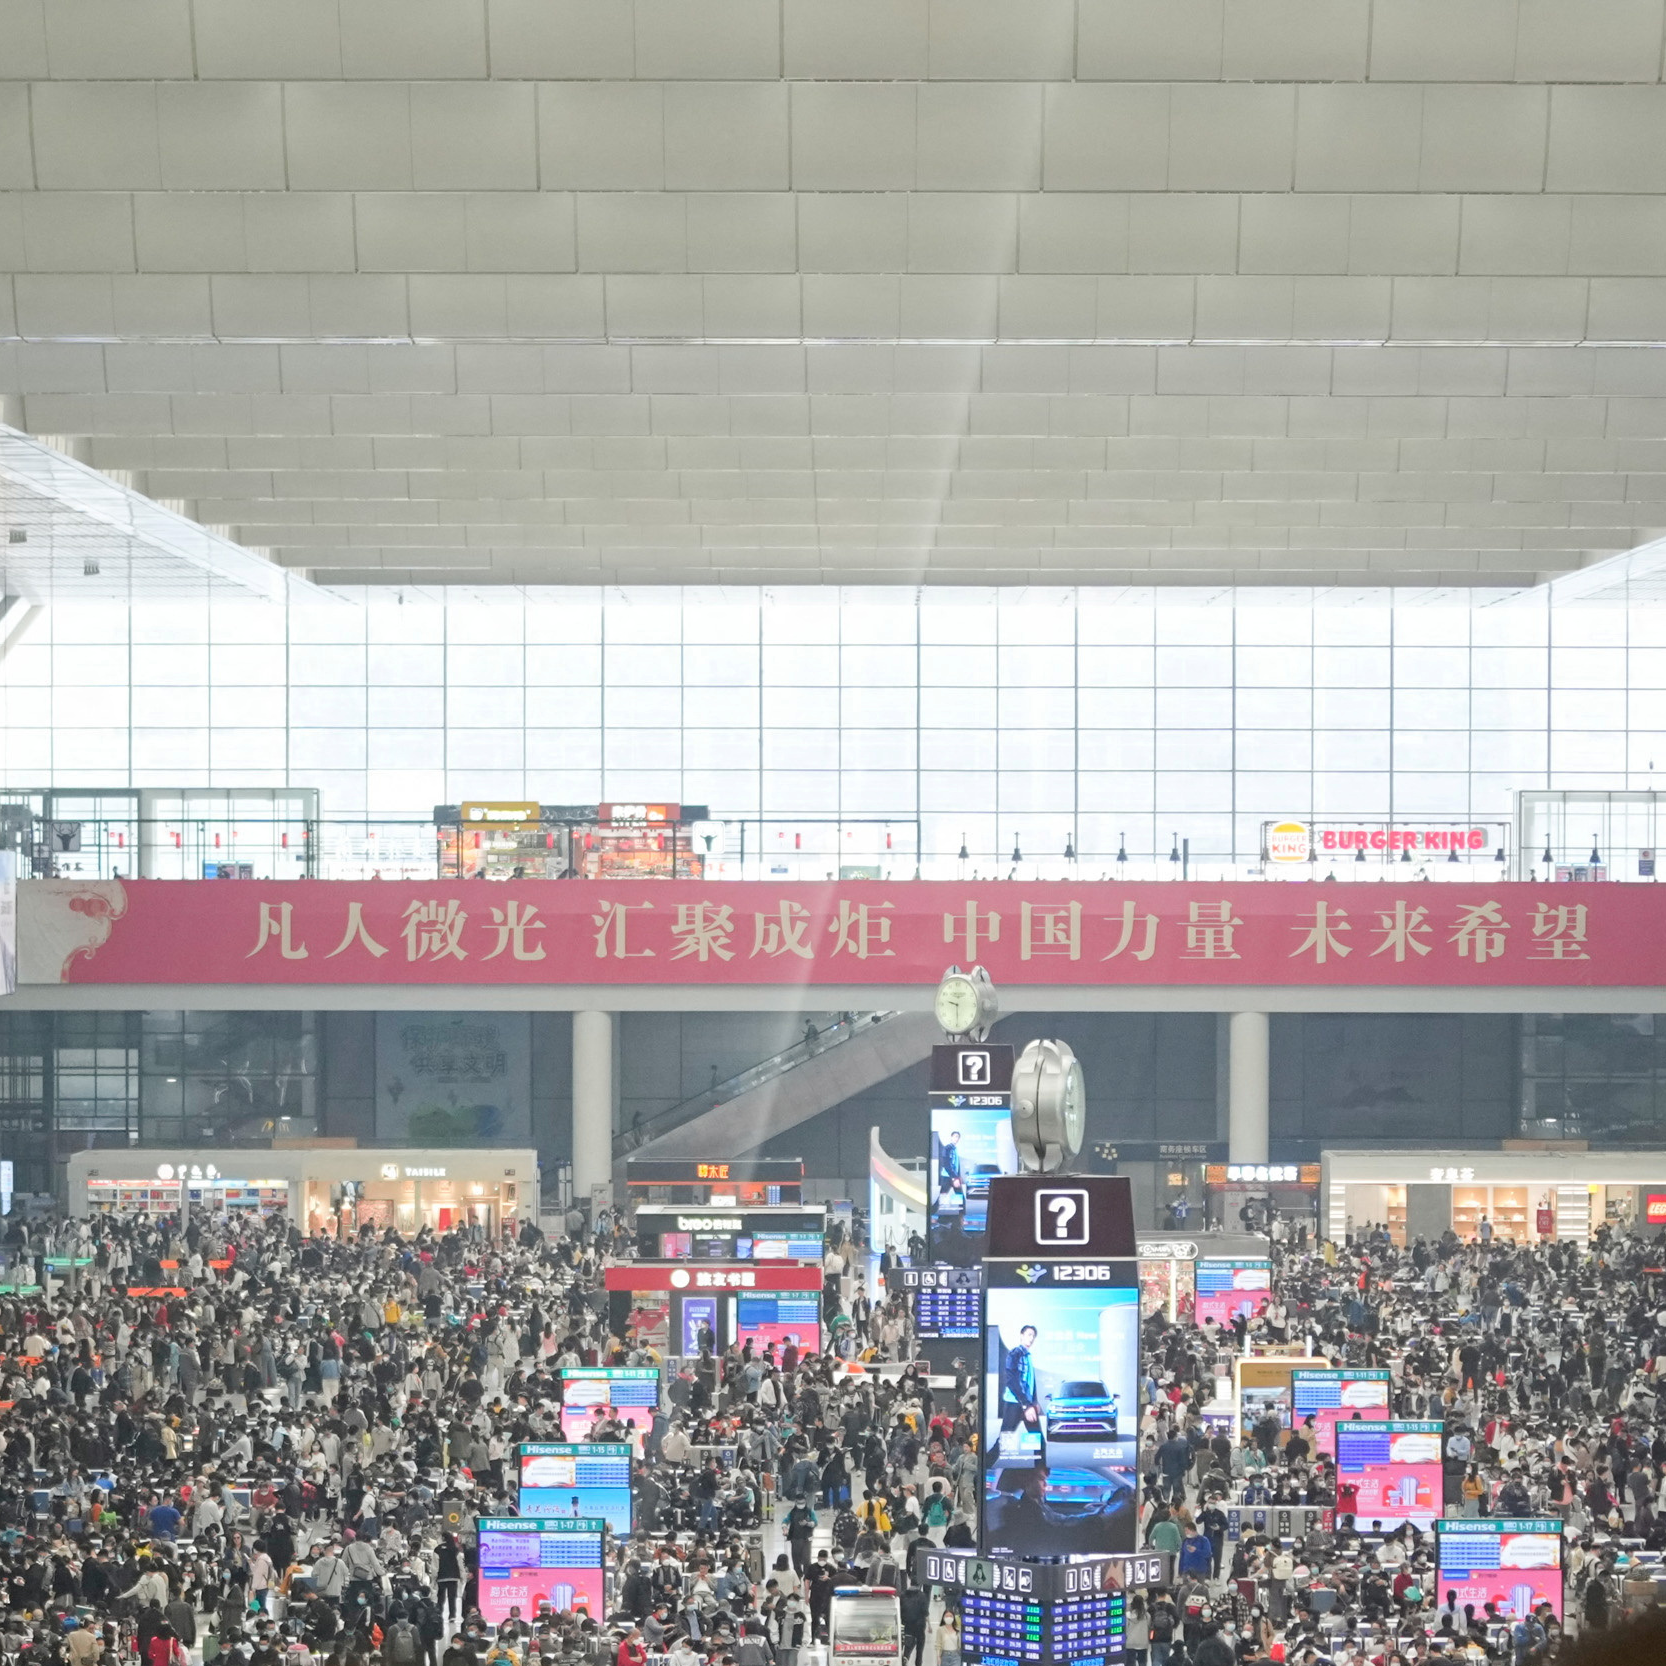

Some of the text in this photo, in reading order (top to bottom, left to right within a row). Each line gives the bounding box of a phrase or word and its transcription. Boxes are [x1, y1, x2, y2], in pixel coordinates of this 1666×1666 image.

[1323, 830, 1485, 850] BURGER KING
[1272, 843, 1307, 854] KING
[245, 899, 1591, 964] 凡人微光 汇聚成炬 中国力量 未来希望
[969, 1096, 1003, 1106] 12306
[677, 1216, 713, 1231] breo
[1053, 1265, 1111, 1281] 12306
[742, 1291, 776, 1299] Hisense
[567, 1370, 608, 1378] Hisense
[1298, 1371, 1367, 1380] Hisense 1-11
[1343, 1422, 1419, 1432] Hisense 1-15
[526, 1445, 605, 1454] Hisense 1-15
[486, 1520, 574, 1530] Hisense 1-17
[1445, 1521, 1533, 1532] Hisense 1-17
